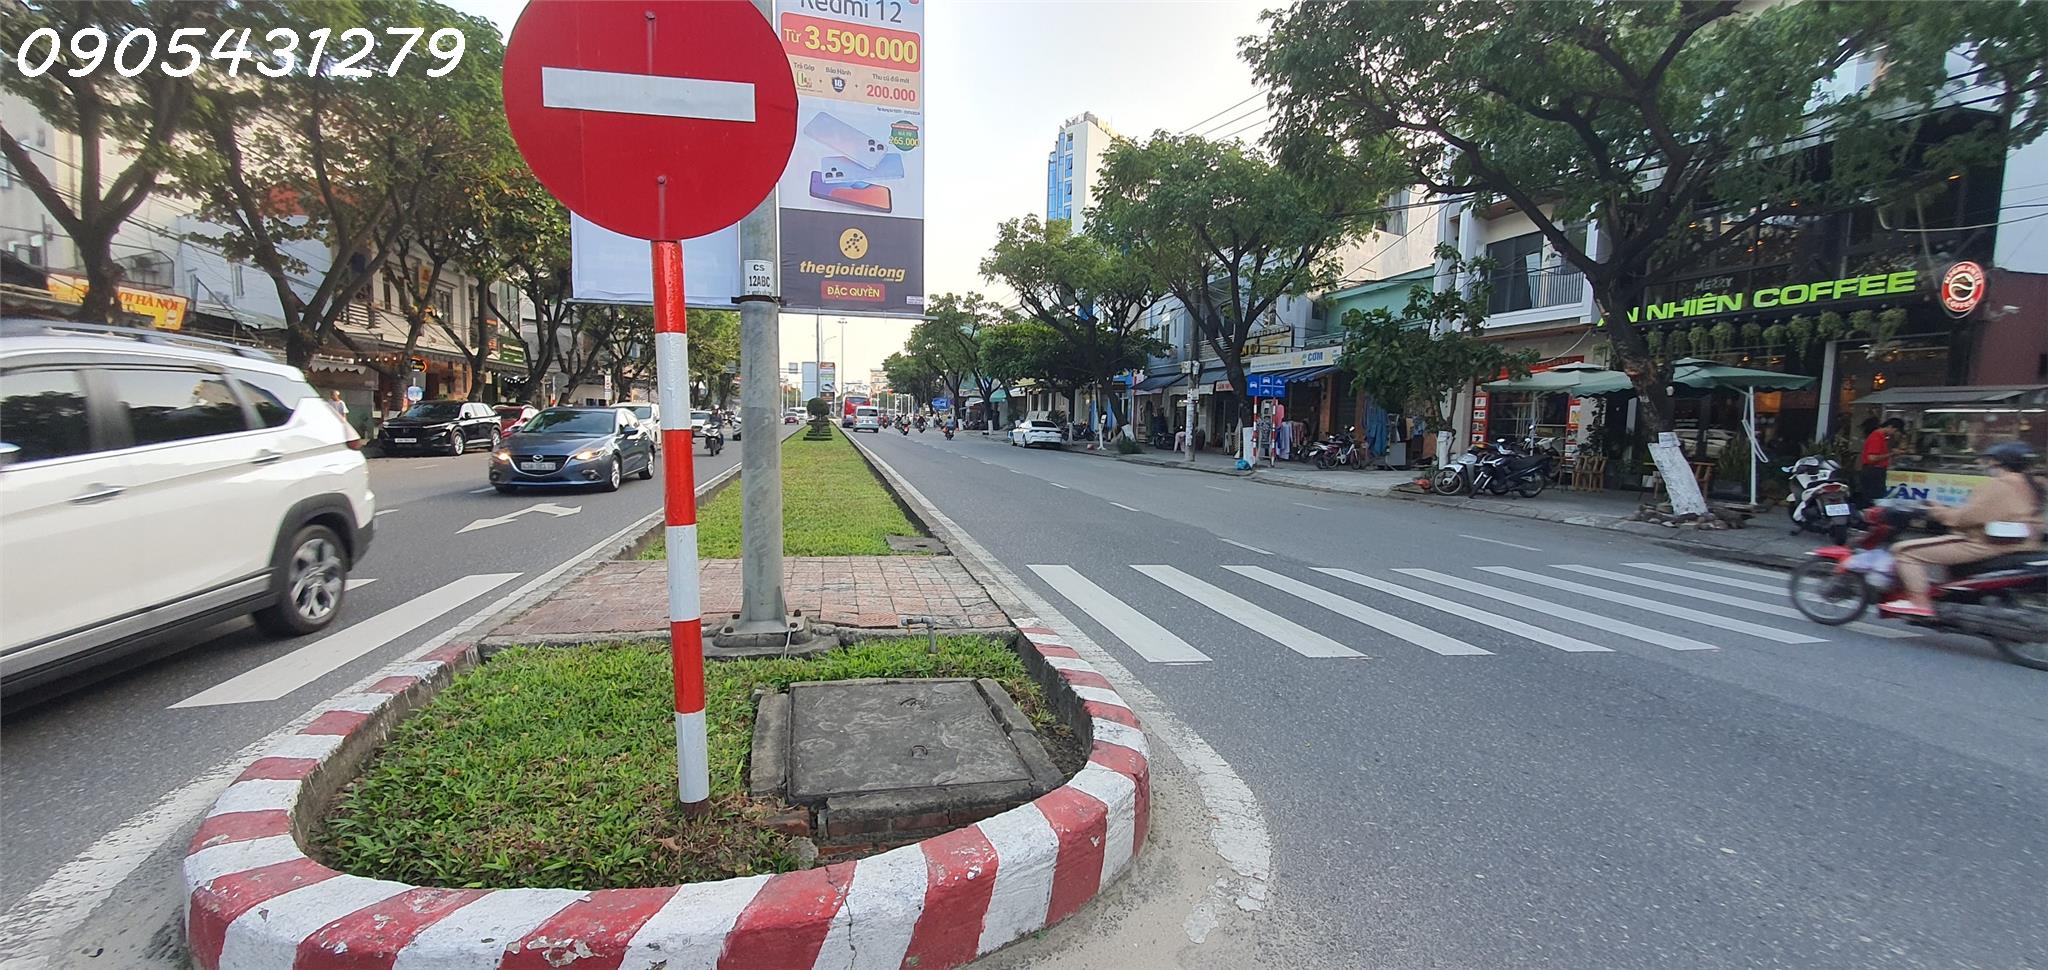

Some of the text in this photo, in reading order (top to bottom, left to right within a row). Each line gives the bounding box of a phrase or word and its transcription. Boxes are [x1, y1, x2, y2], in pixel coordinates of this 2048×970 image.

[876, 1, 903, 23] 12
[784, 25, 918, 64] Từ 3.590.000
[866, 84, 916, 102] 200.000
[749, 275, 771, 288] 12ABC
[800, 261, 905, 282] thegioididong
[827, 284, 880, 298] ĐẶC QUYỀN
[1646, 292, 1743, 320] NHIÊN
[1753, 270, 1917, 308] COFFEE
